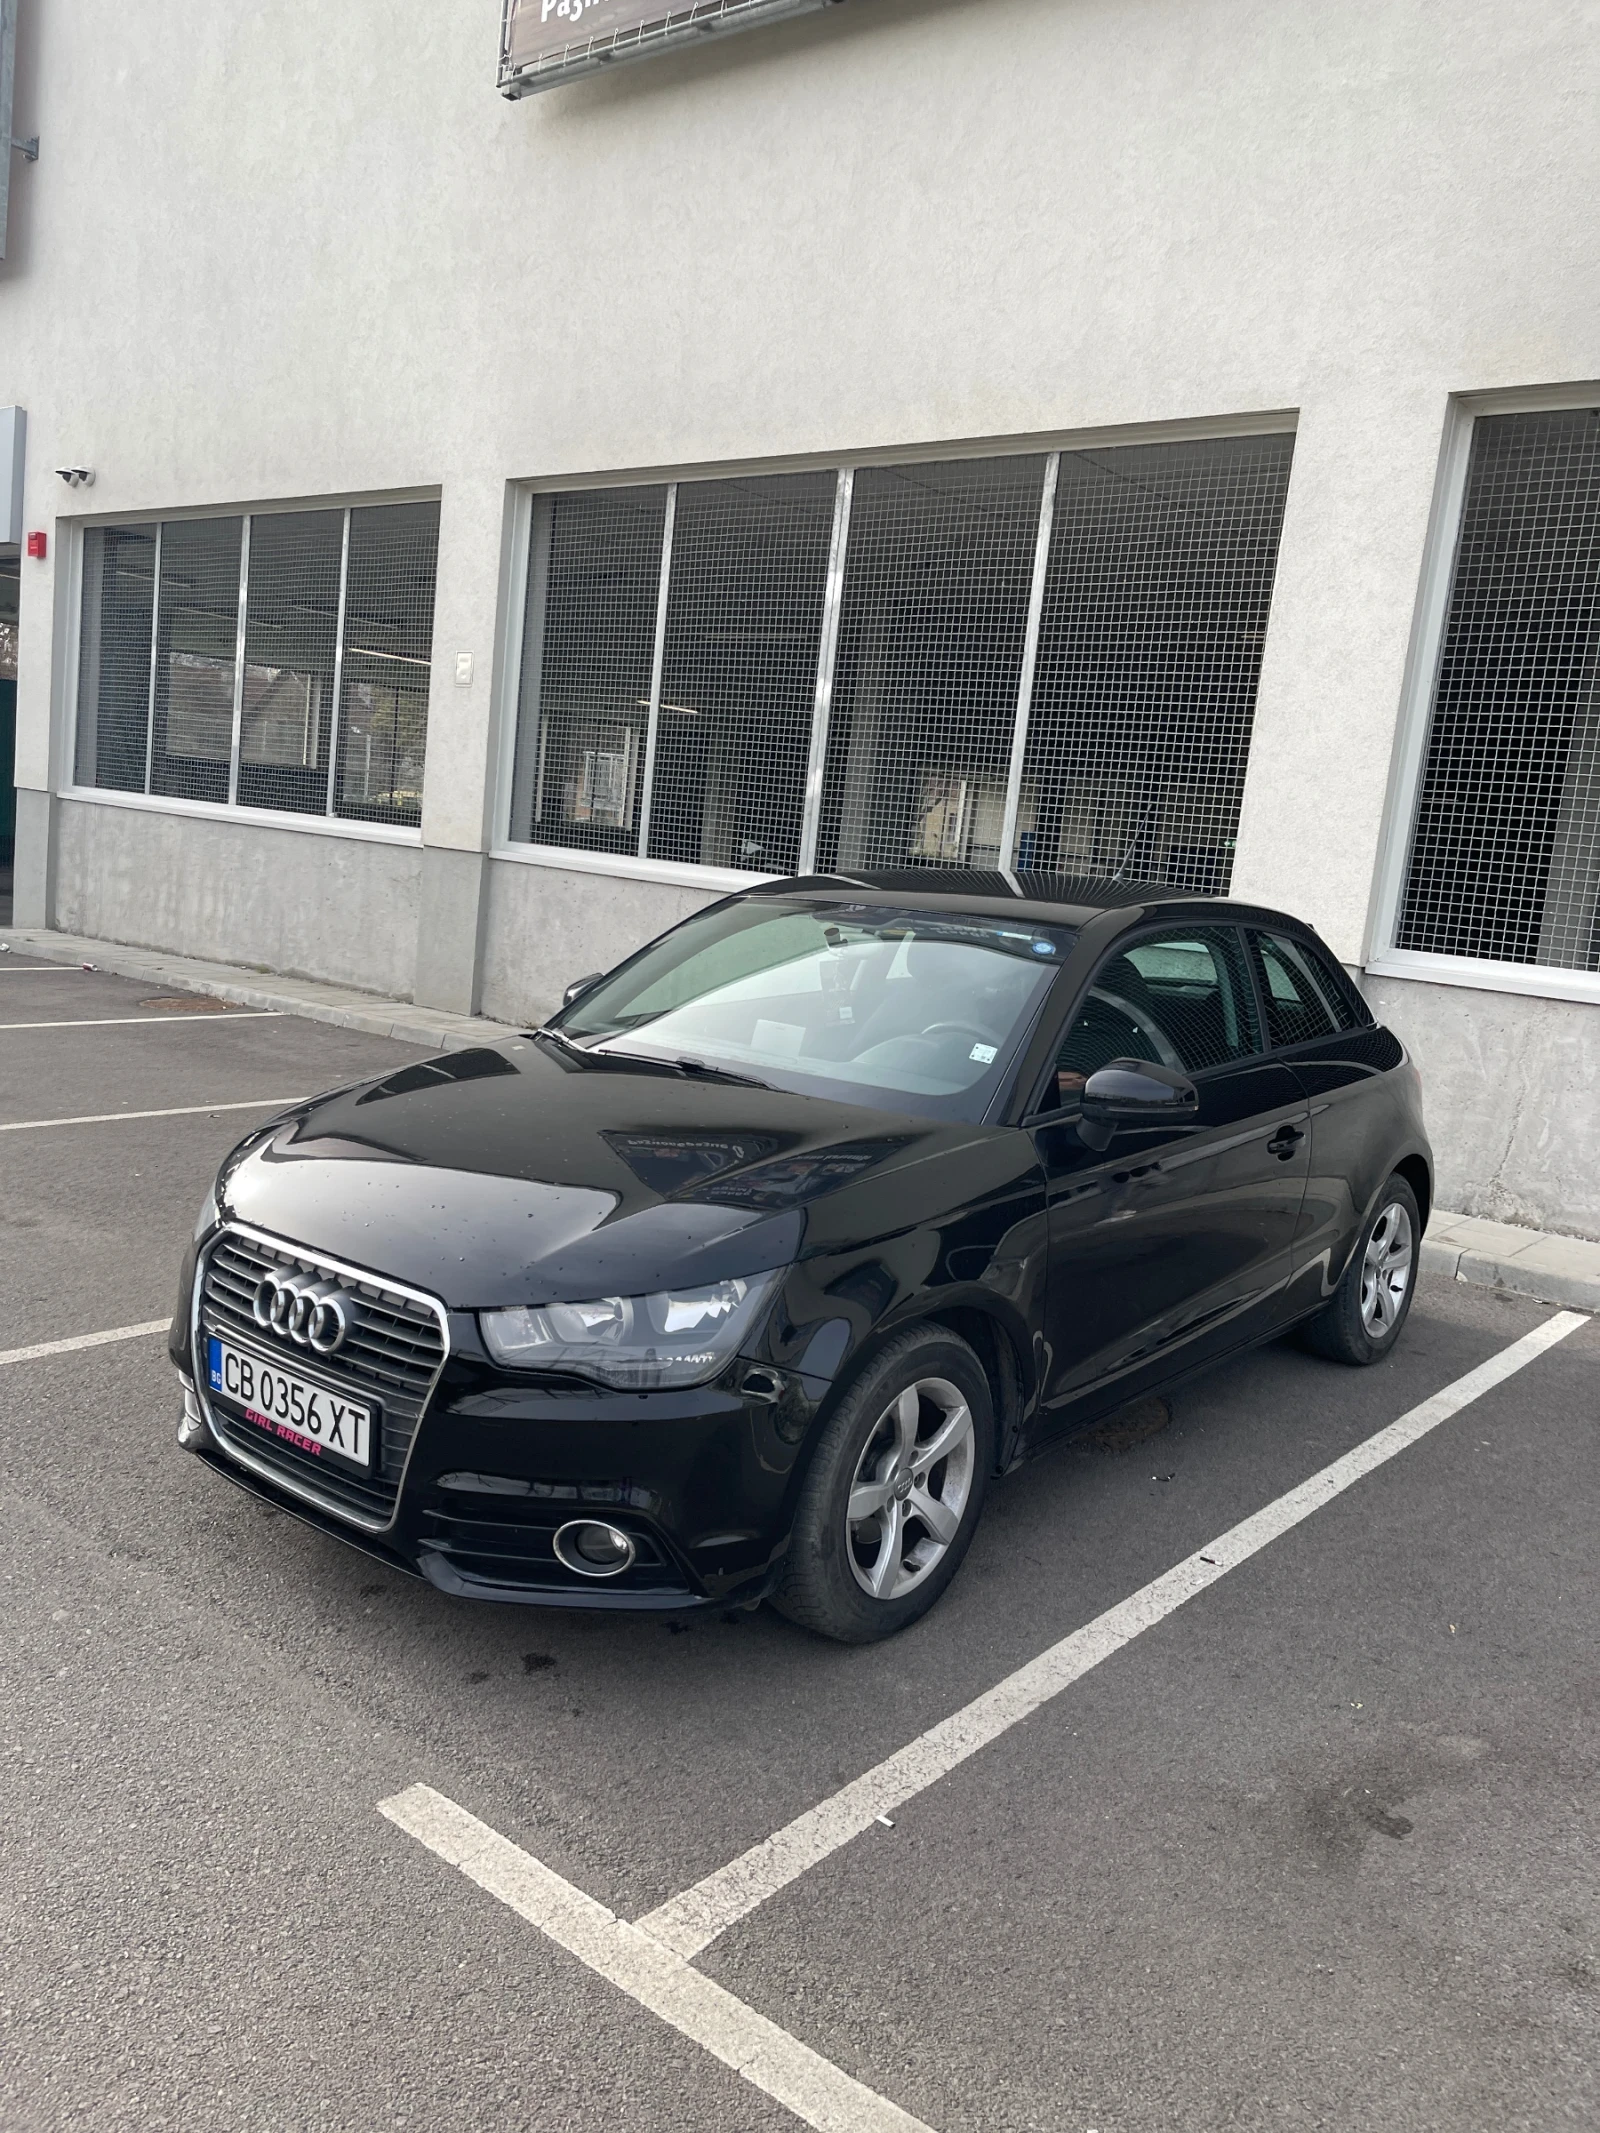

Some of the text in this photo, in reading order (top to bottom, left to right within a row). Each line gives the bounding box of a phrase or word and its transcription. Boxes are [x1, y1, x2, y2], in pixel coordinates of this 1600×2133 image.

[211, 1370, 222, 1385] BG
[245, 1408, 322, 1455] GIRL RACER
